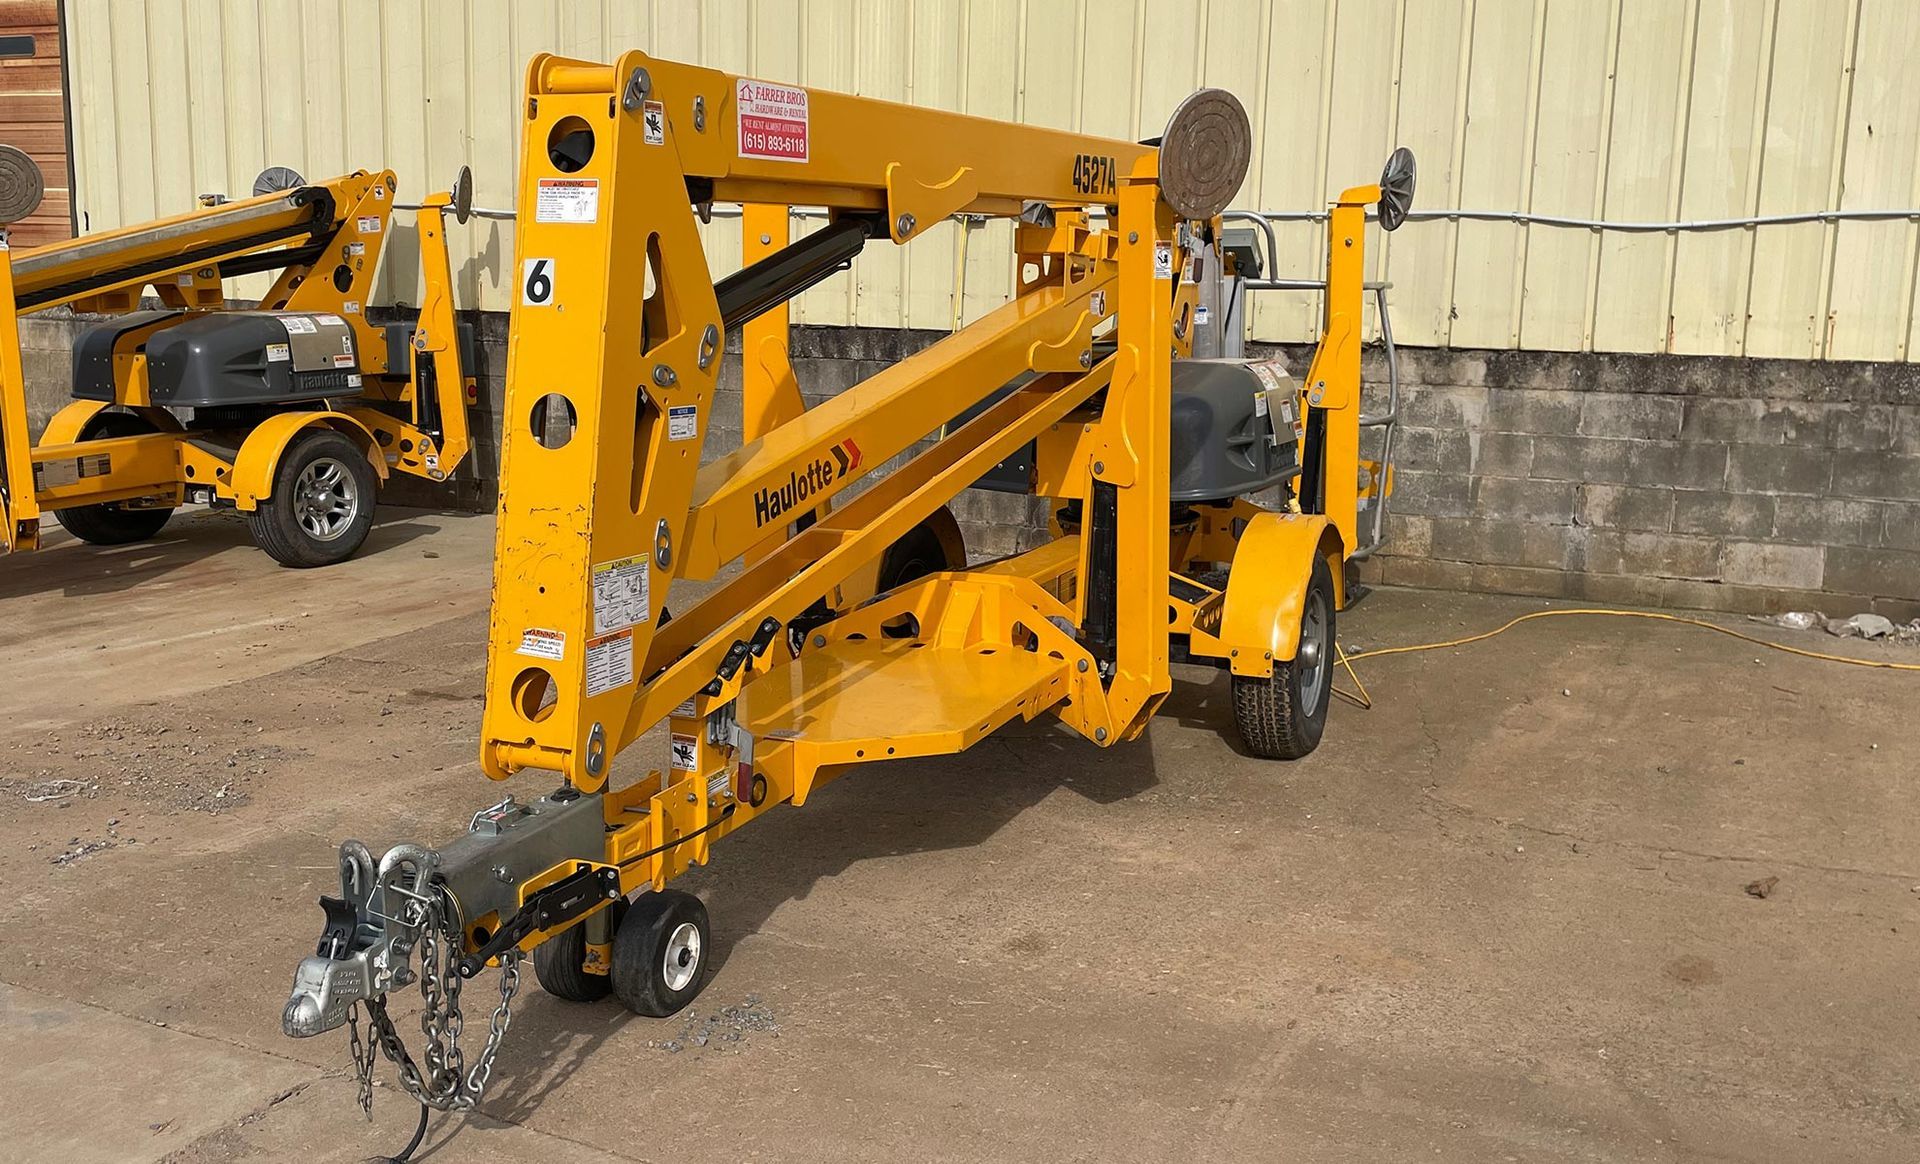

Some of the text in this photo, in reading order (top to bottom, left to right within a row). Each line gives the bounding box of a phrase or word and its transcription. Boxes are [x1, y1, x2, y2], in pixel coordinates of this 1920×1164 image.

[755, 86, 806, 106] FARRER BROS
[754, 103, 784, 117] HARDWARE
[789, 108, 807, 119] RENTAL
[743, 130, 805, 153] (615) 893-6118
[1072, 153, 1116, 196] 4527A
[526, 259, 552, 304] 6
[1099, 290, 1105, 316] 6
[753, 458, 833, 529] Haulotte
